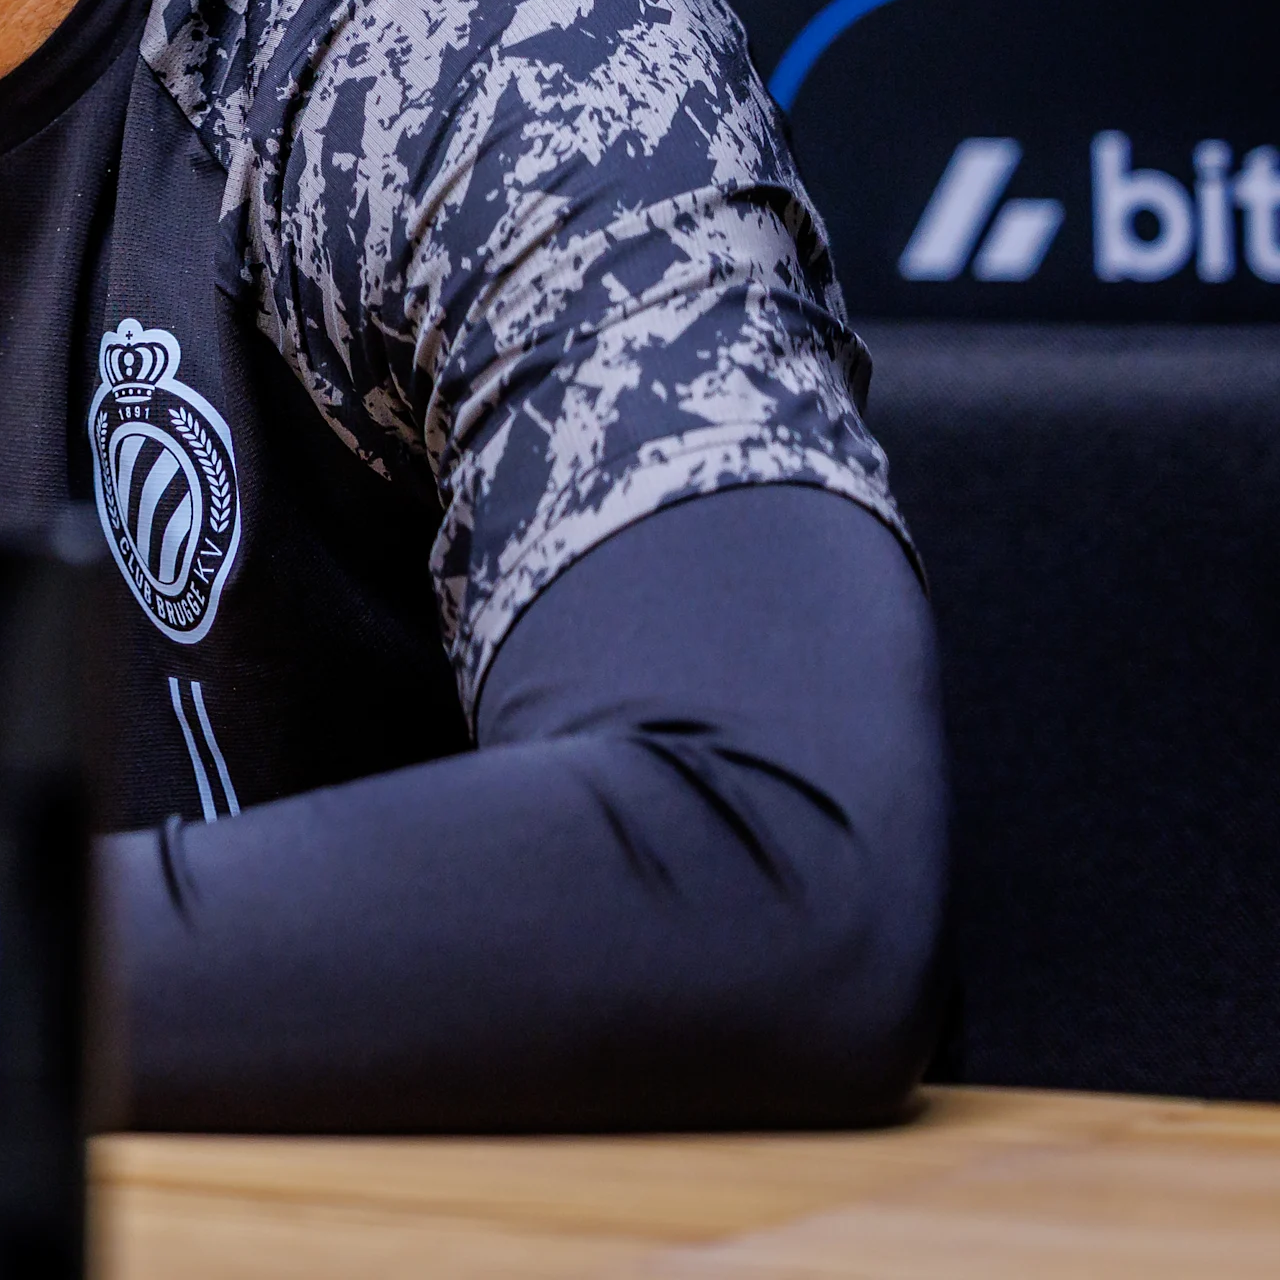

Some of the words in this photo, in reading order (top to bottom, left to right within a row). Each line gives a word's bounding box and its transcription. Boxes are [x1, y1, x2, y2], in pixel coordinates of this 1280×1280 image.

[118, 406, 150, 421] 1891
[120, 536, 152, 605] CLUB
[156, 581, 206, 627] BRUGGE
[193, 537, 223, 585] KV
